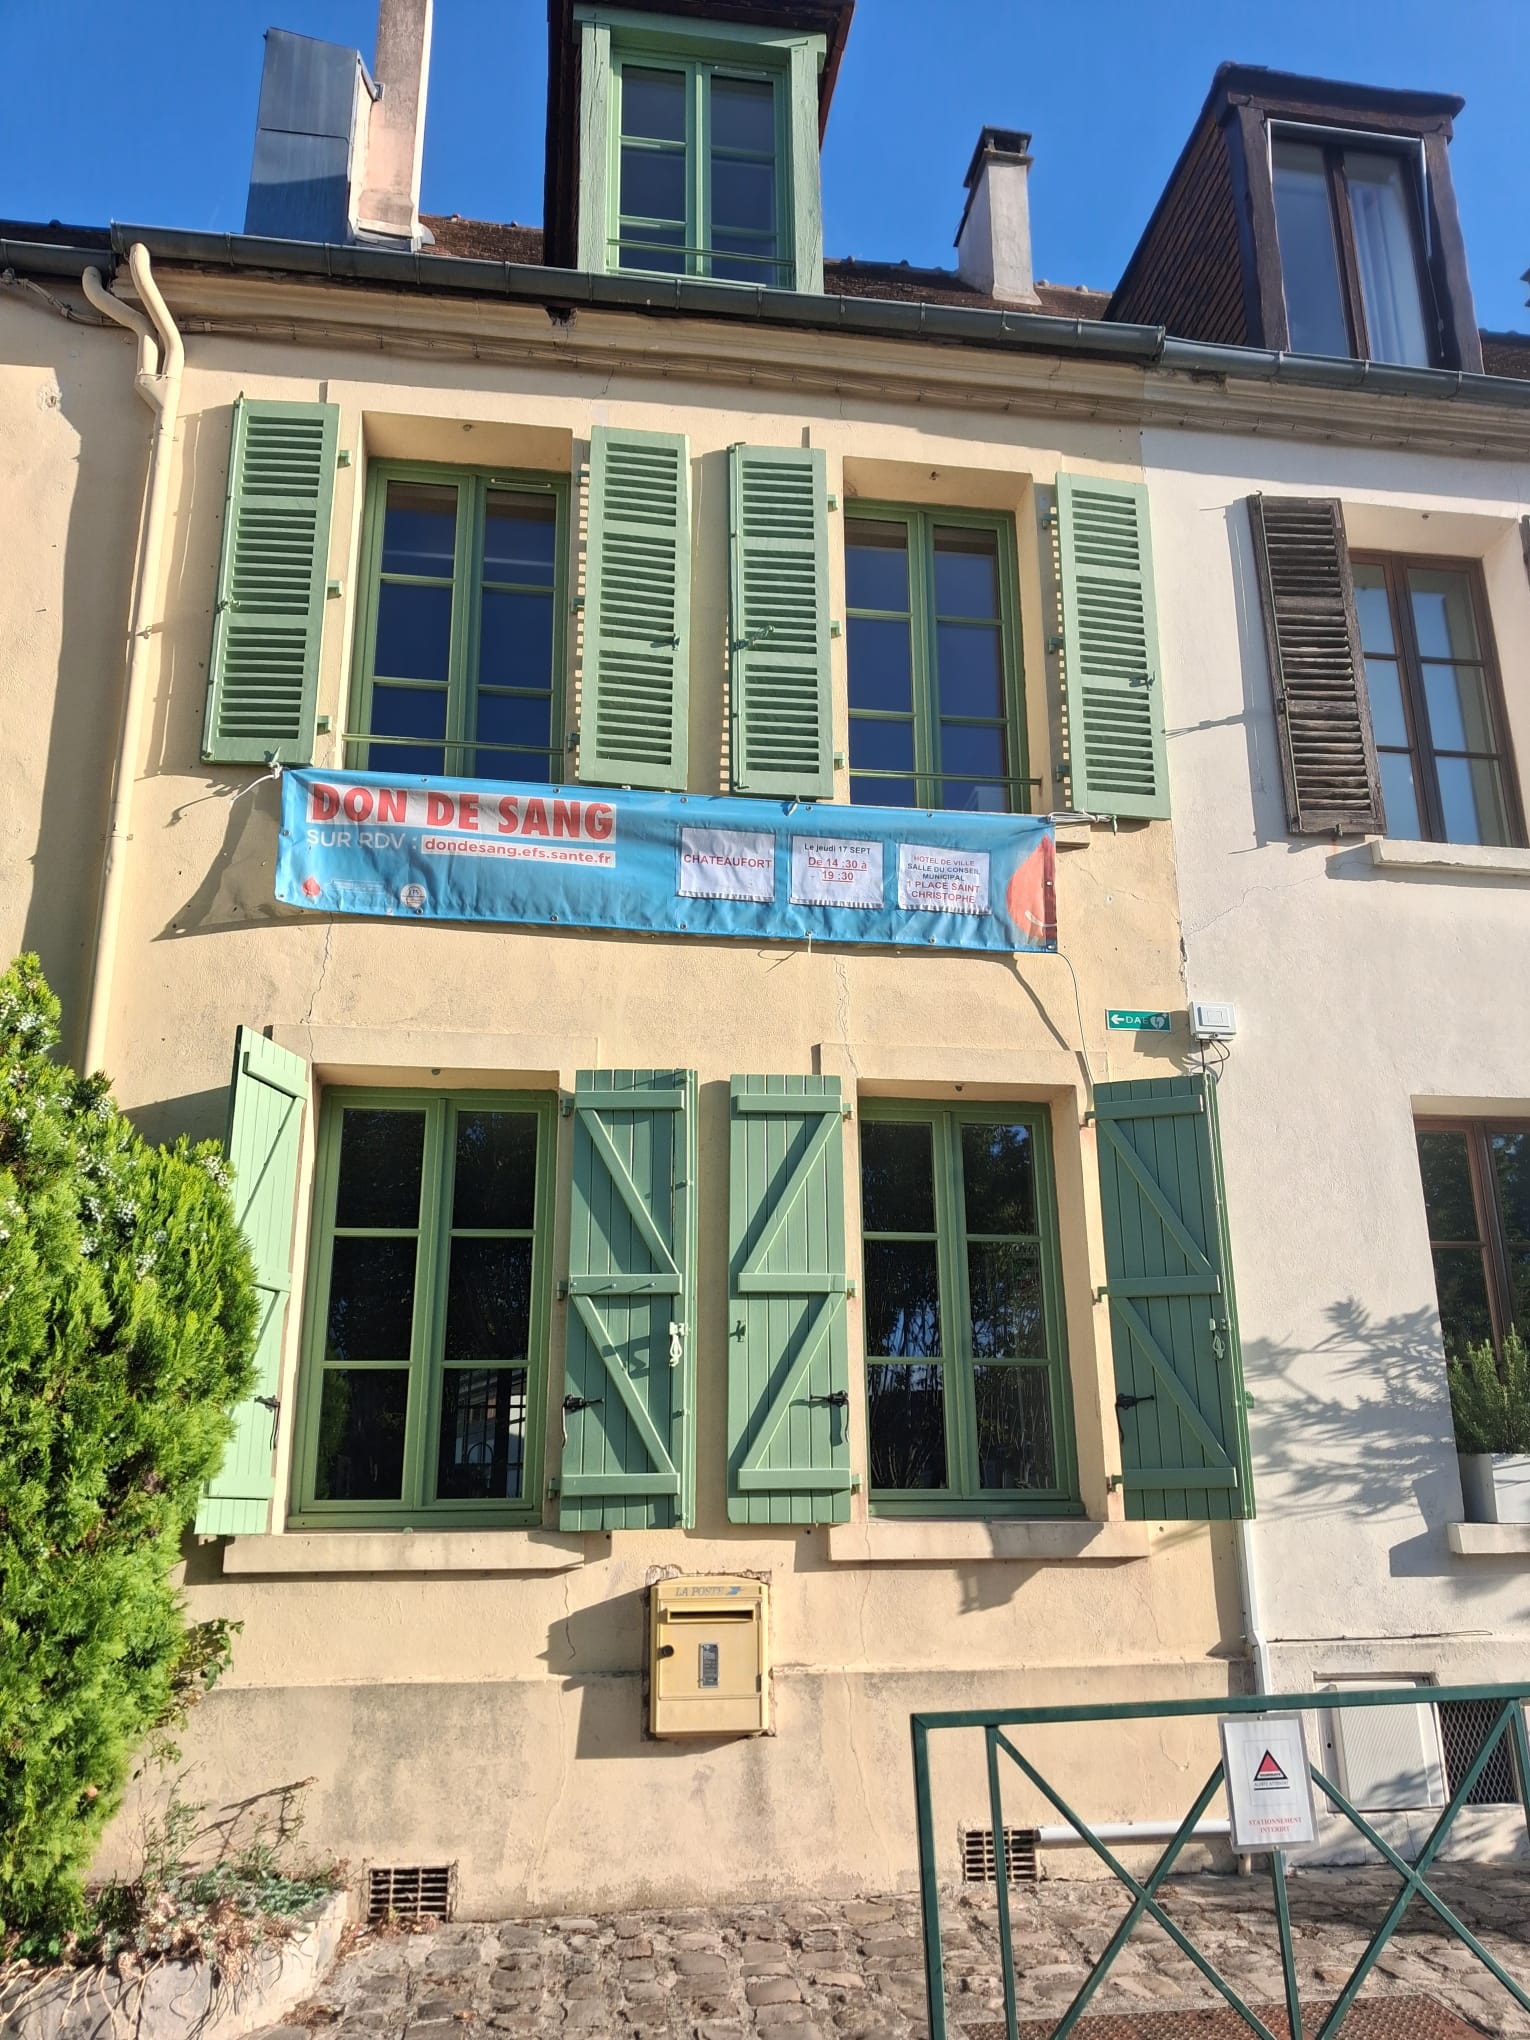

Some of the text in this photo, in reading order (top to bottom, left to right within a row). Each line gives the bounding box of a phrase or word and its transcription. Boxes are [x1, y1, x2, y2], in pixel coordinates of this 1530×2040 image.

[312, 783, 615, 840] DON DE SANG
[307, 830, 351, 848] SUR
[359, 832, 406, 850] RDV
[424, 838, 611, 865] dondesang.efs.sante.fr
[804, 843, 871, 855] Le jeudi 17 SEPT
[683, 854, 772, 868] CHATEAUFORT
[808, 857, 823, 866] De
[826, 858, 838, 867] 14
[953, 859, 975, 867] VILLE
[822, 870, 834, 880] 19
[907, 863, 932, 872] SALLE
[946, 866, 980, 875] CONSEIL
[922, 873, 965, 882] MUNICIPAL
[915, 881, 948, 890] PLACE
[951, 883, 980, 893] SAINT
[911, 891, 976, 904] CHRISTOPHE
[1125, 1015, 1149, 1024] DAE
